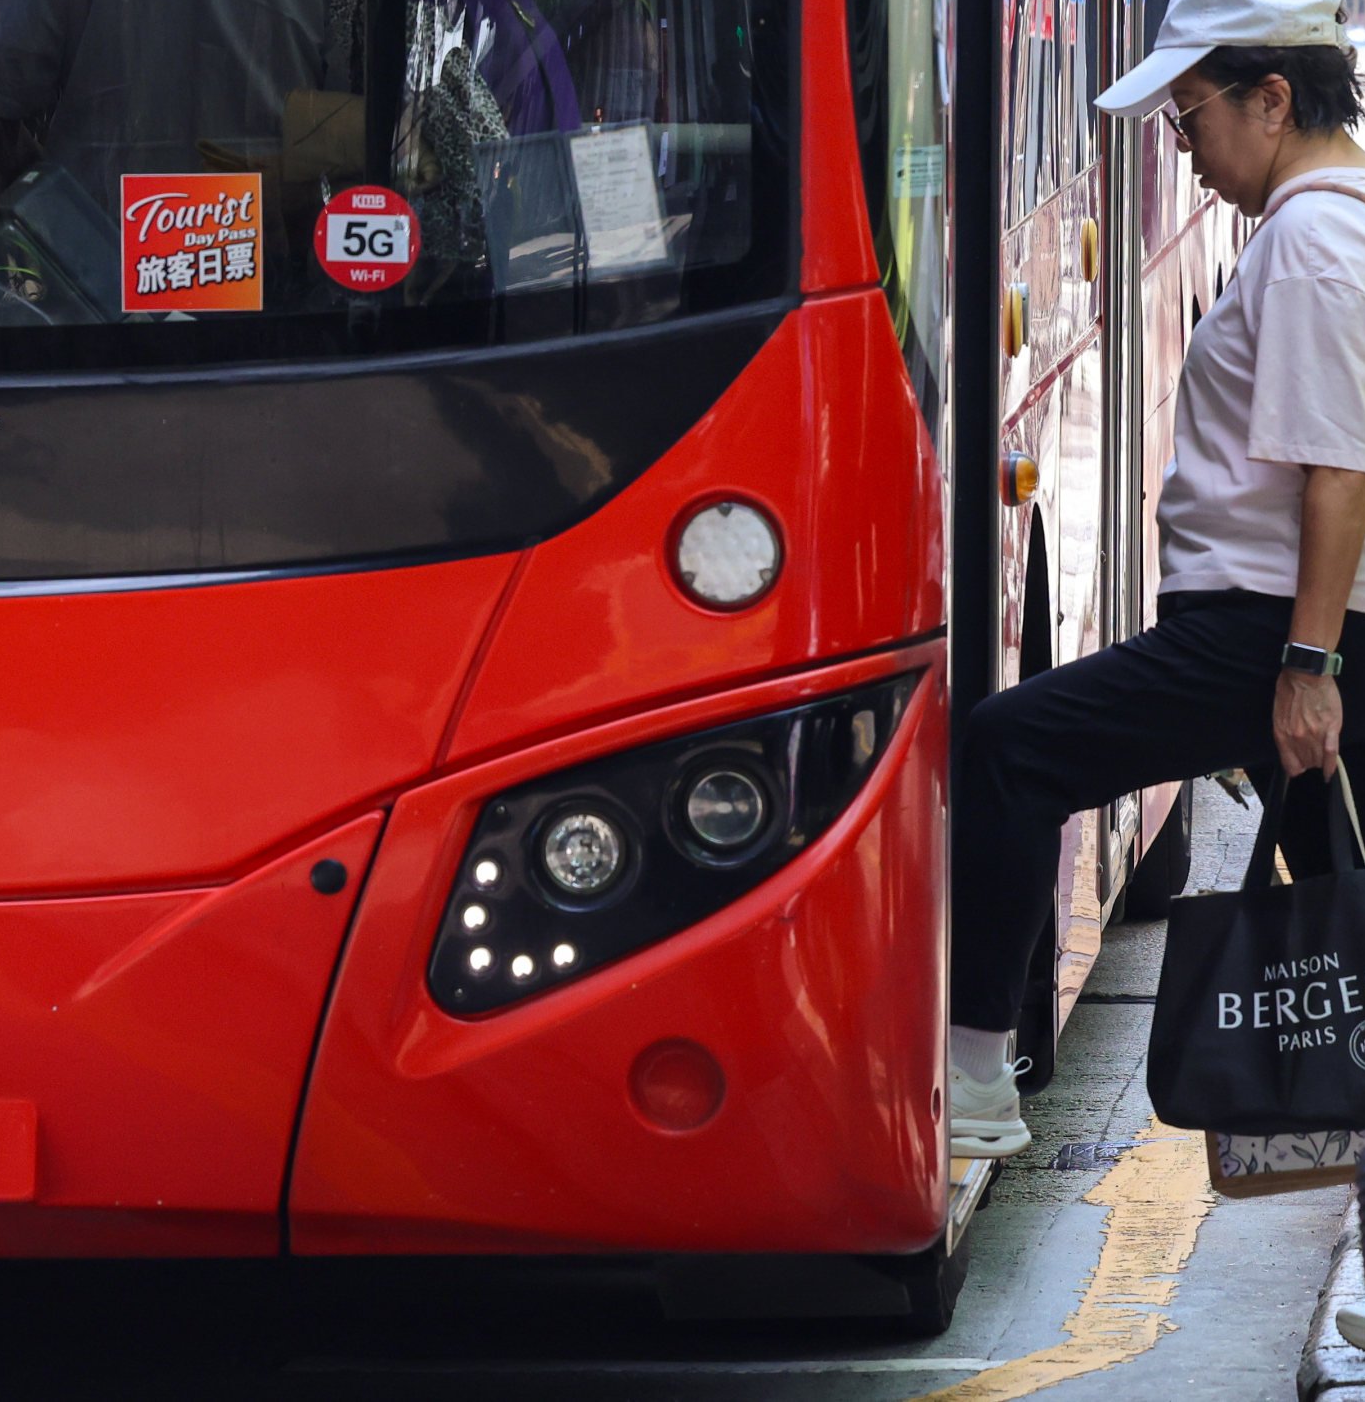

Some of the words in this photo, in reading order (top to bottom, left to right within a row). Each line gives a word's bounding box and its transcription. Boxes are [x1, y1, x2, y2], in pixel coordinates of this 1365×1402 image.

[352, 194, 386, 209] KMB
[126, 191, 253, 243] Tourist
[185, 230, 215, 247] Day
[218, 227, 257, 243] Pass
[342, 222, 393, 258] 5G
[136, 242, 255, 294] 旅客日票
[350, 269, 385, 283] Wi-Fi
[1264, 952, 1340, 982] MAISON
[1278, 1026, 1337, 1052] PARIS
